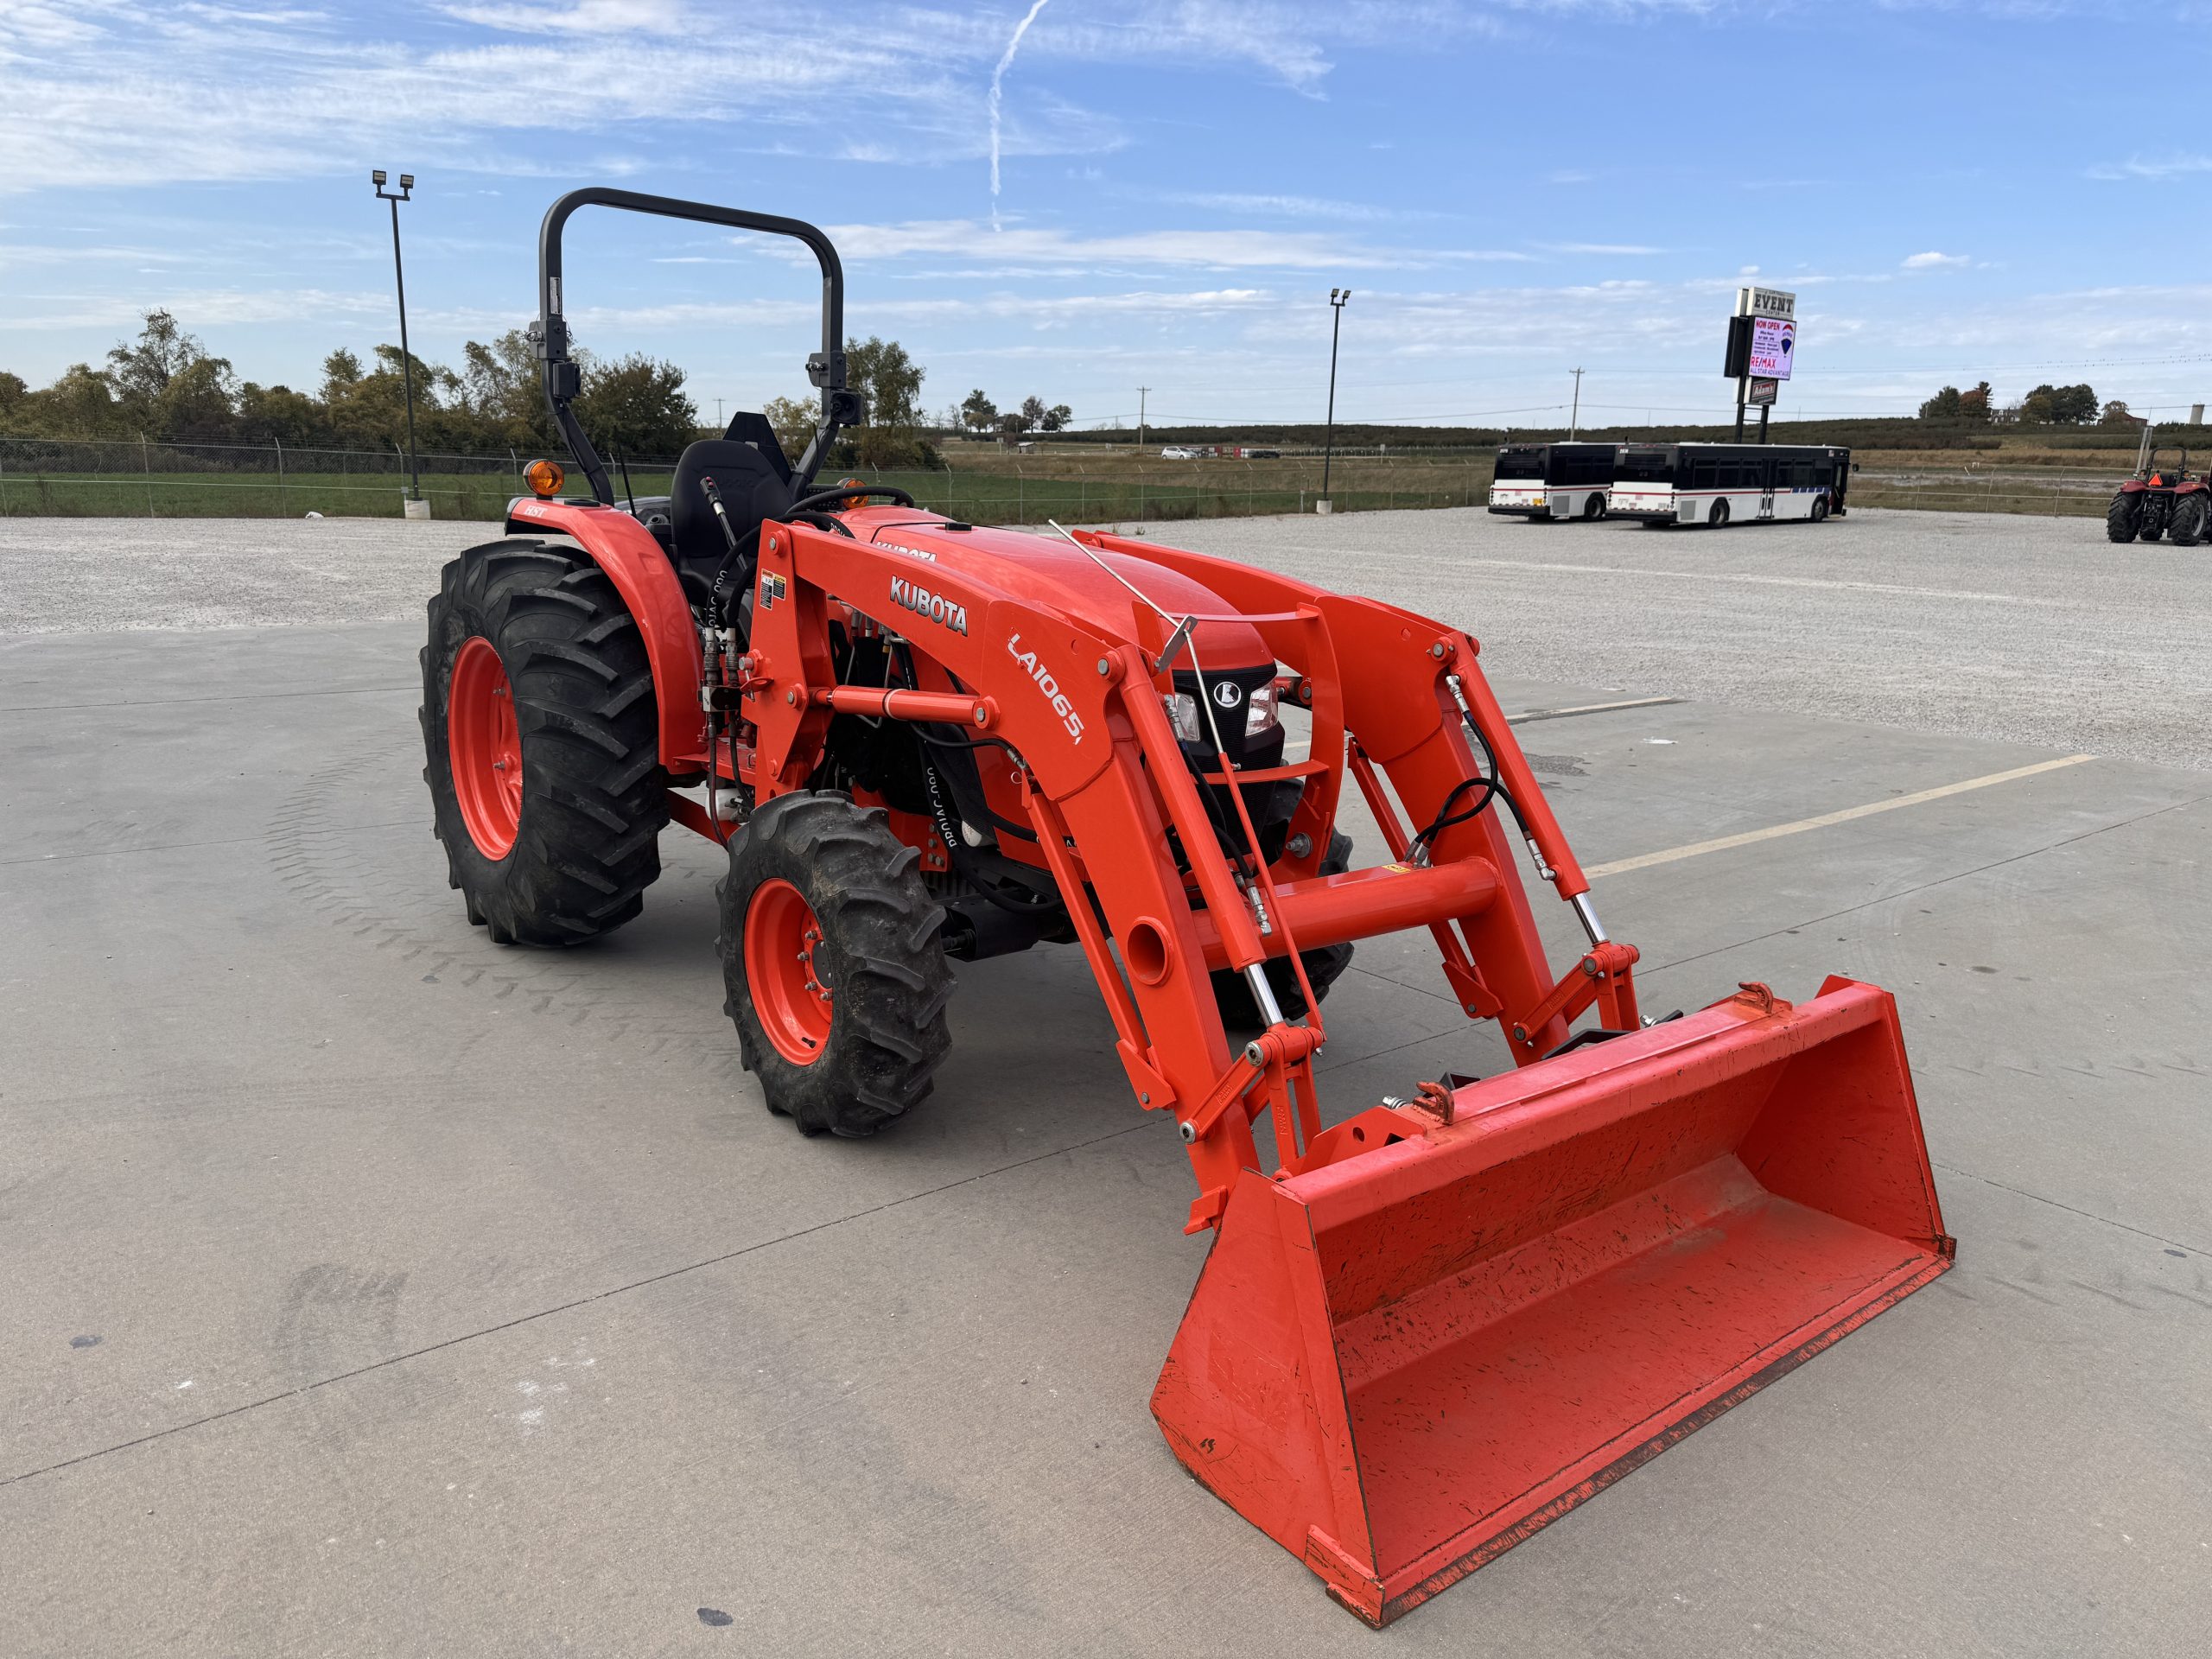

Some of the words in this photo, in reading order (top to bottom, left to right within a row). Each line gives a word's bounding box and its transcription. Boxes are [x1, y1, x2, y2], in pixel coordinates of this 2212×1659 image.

[1754, 294, 1793, 313] EVENT
[1756, 321, 1767, 329] NOW
[1768, 321, 1780, 331] OPEN
[1750, 356, 1776, 369] RE/MAX
[524, 505, 549, 518] HST
[890, 575, 968, 637] KUBOTA
[1007, 633, 1084, 737] LA1065
